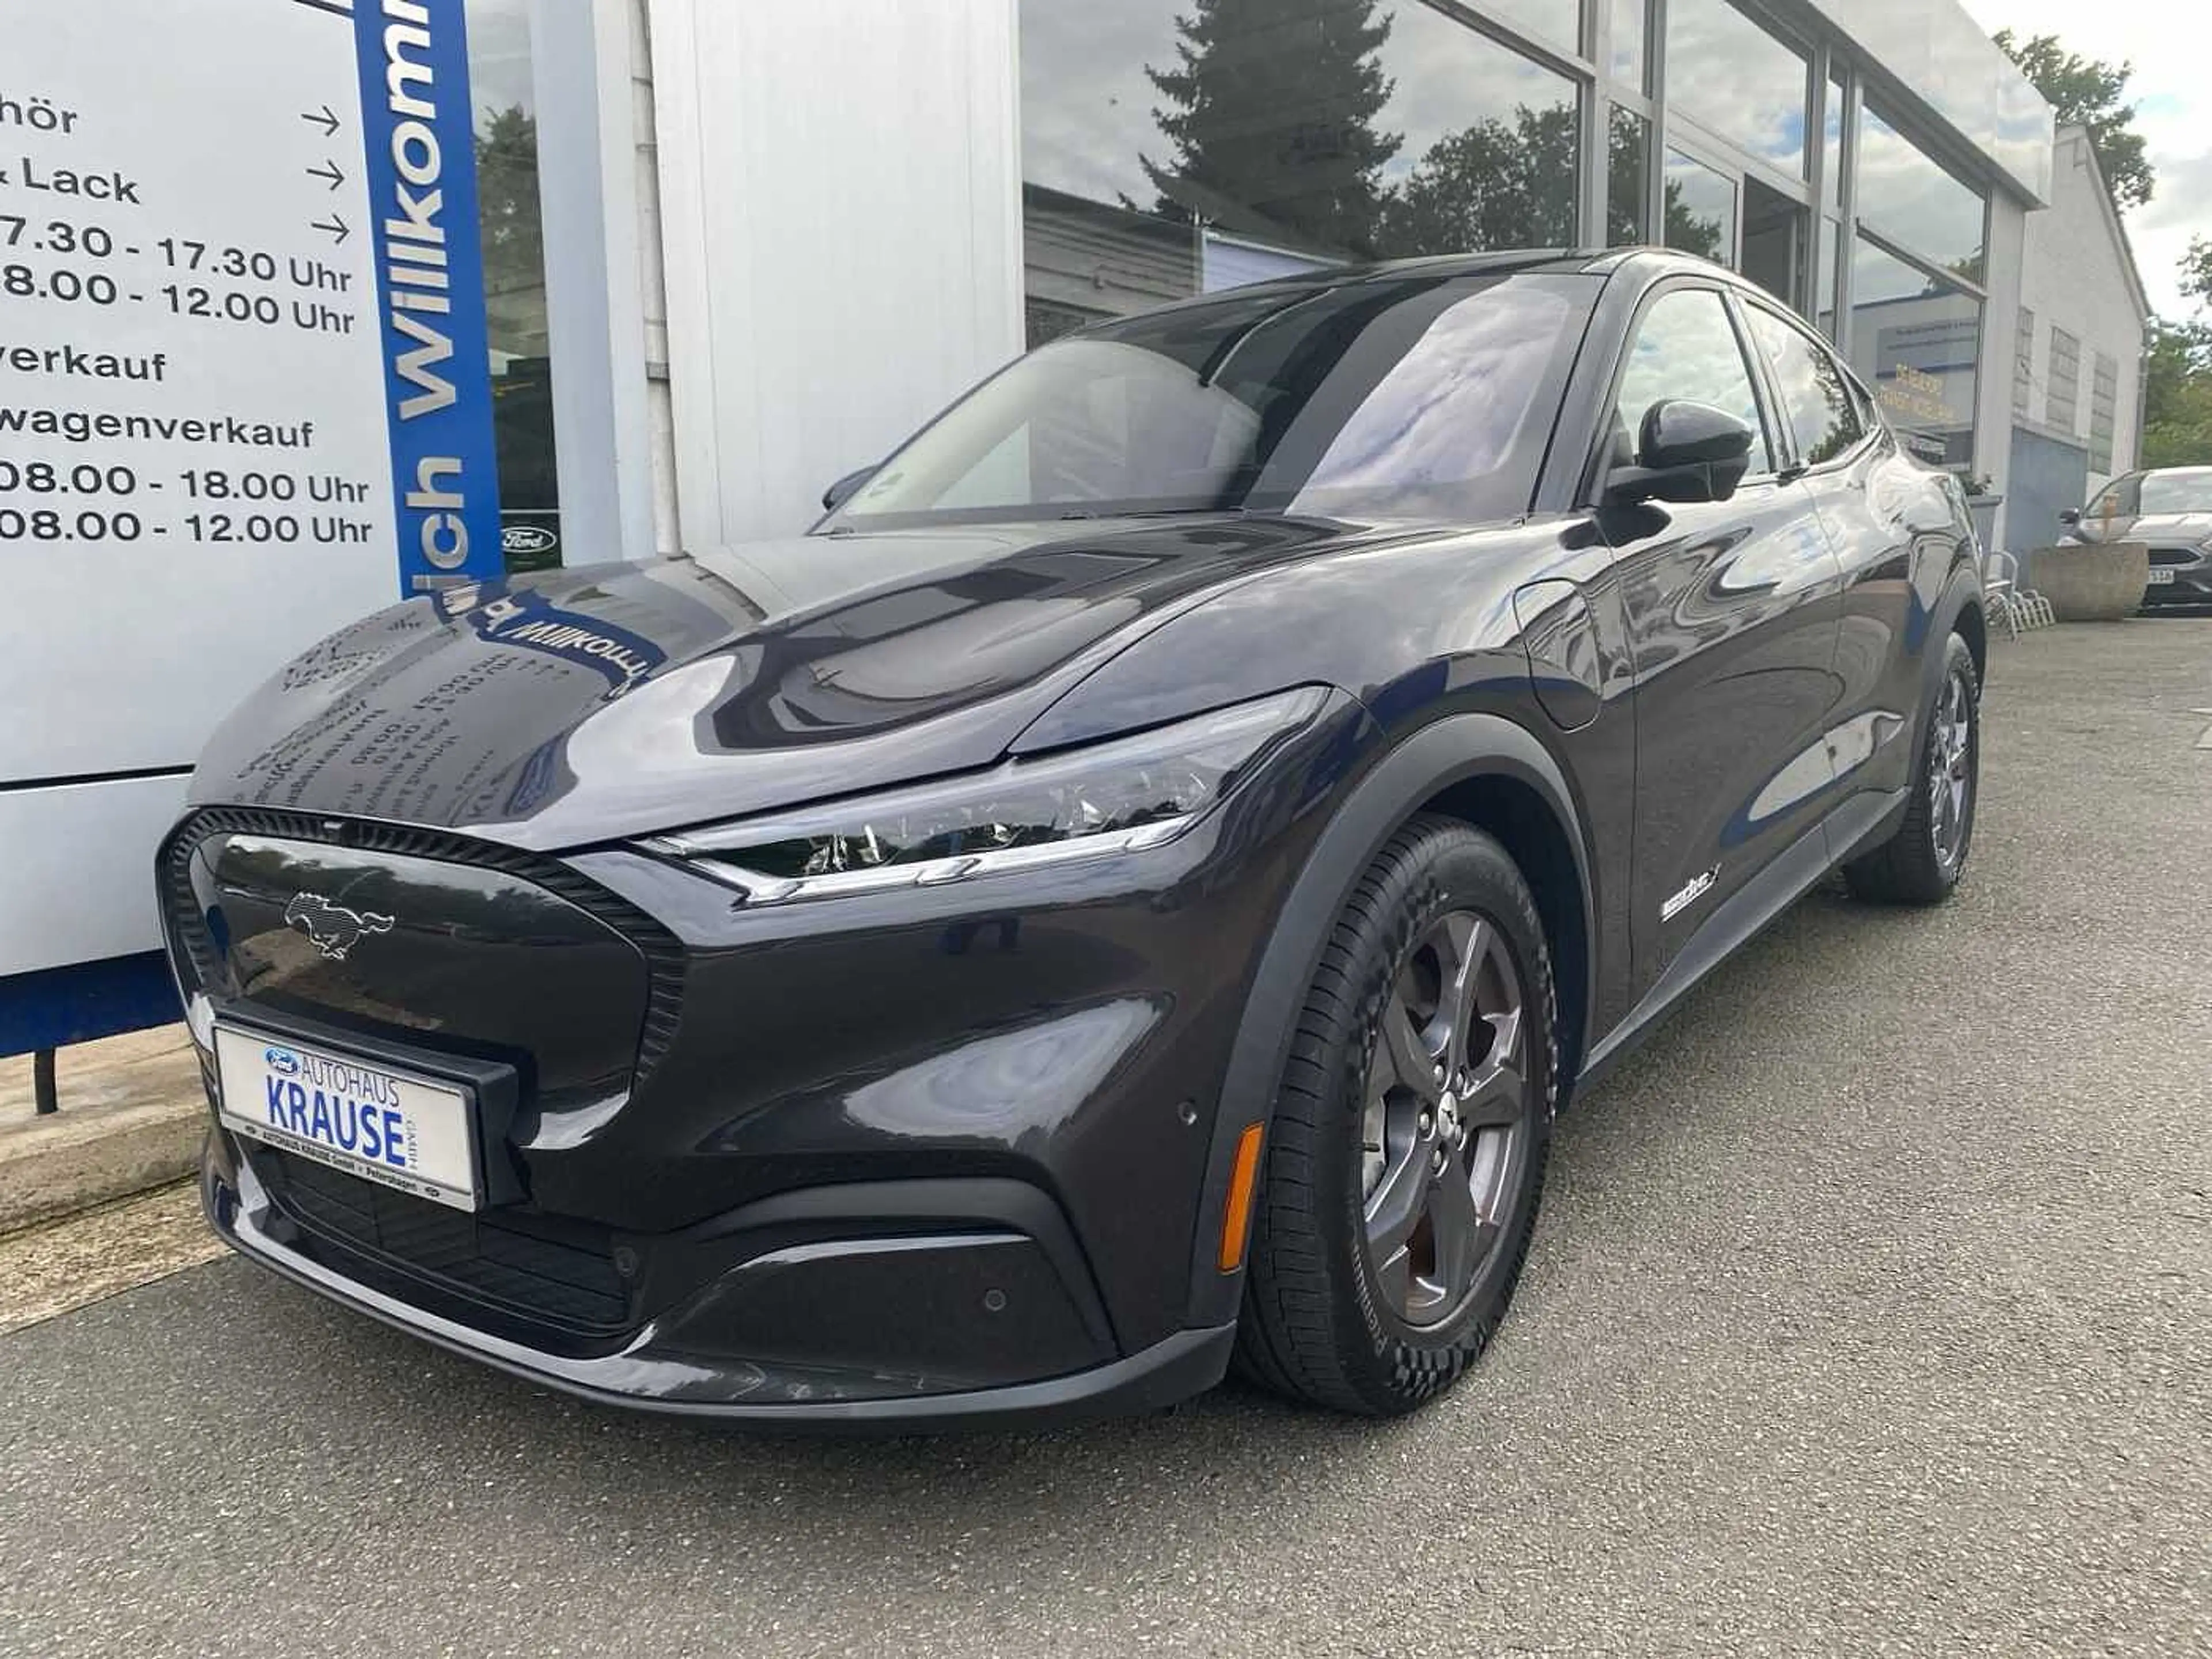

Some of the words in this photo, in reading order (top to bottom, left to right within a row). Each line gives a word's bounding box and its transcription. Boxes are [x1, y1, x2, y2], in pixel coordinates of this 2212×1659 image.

[22, 157, 140, 204] Lack
[157, 238, 276, 281] 17.30
[290, 257, 352, 292] Uhr
[161, 285, 280, 324] 12.00
[292, 301, 355, 334] Uhr
[0, 344, 166, 381] erkauf
[0, 460, 136, 495] 08.00
[180, 470, 296, 501] 18.00
[308, 475, 369, 503] Uhr
[0, 509, 141, 541] 08.00
[184, 514, 300, 543] 12.00
[312, 517, 373, 543] Uhr
[502, 531, 544, 547] Ford
[301, 1056, 400, 1107] AUTOHAUS
[266, 1074, 406, 1167] KRAUSE
